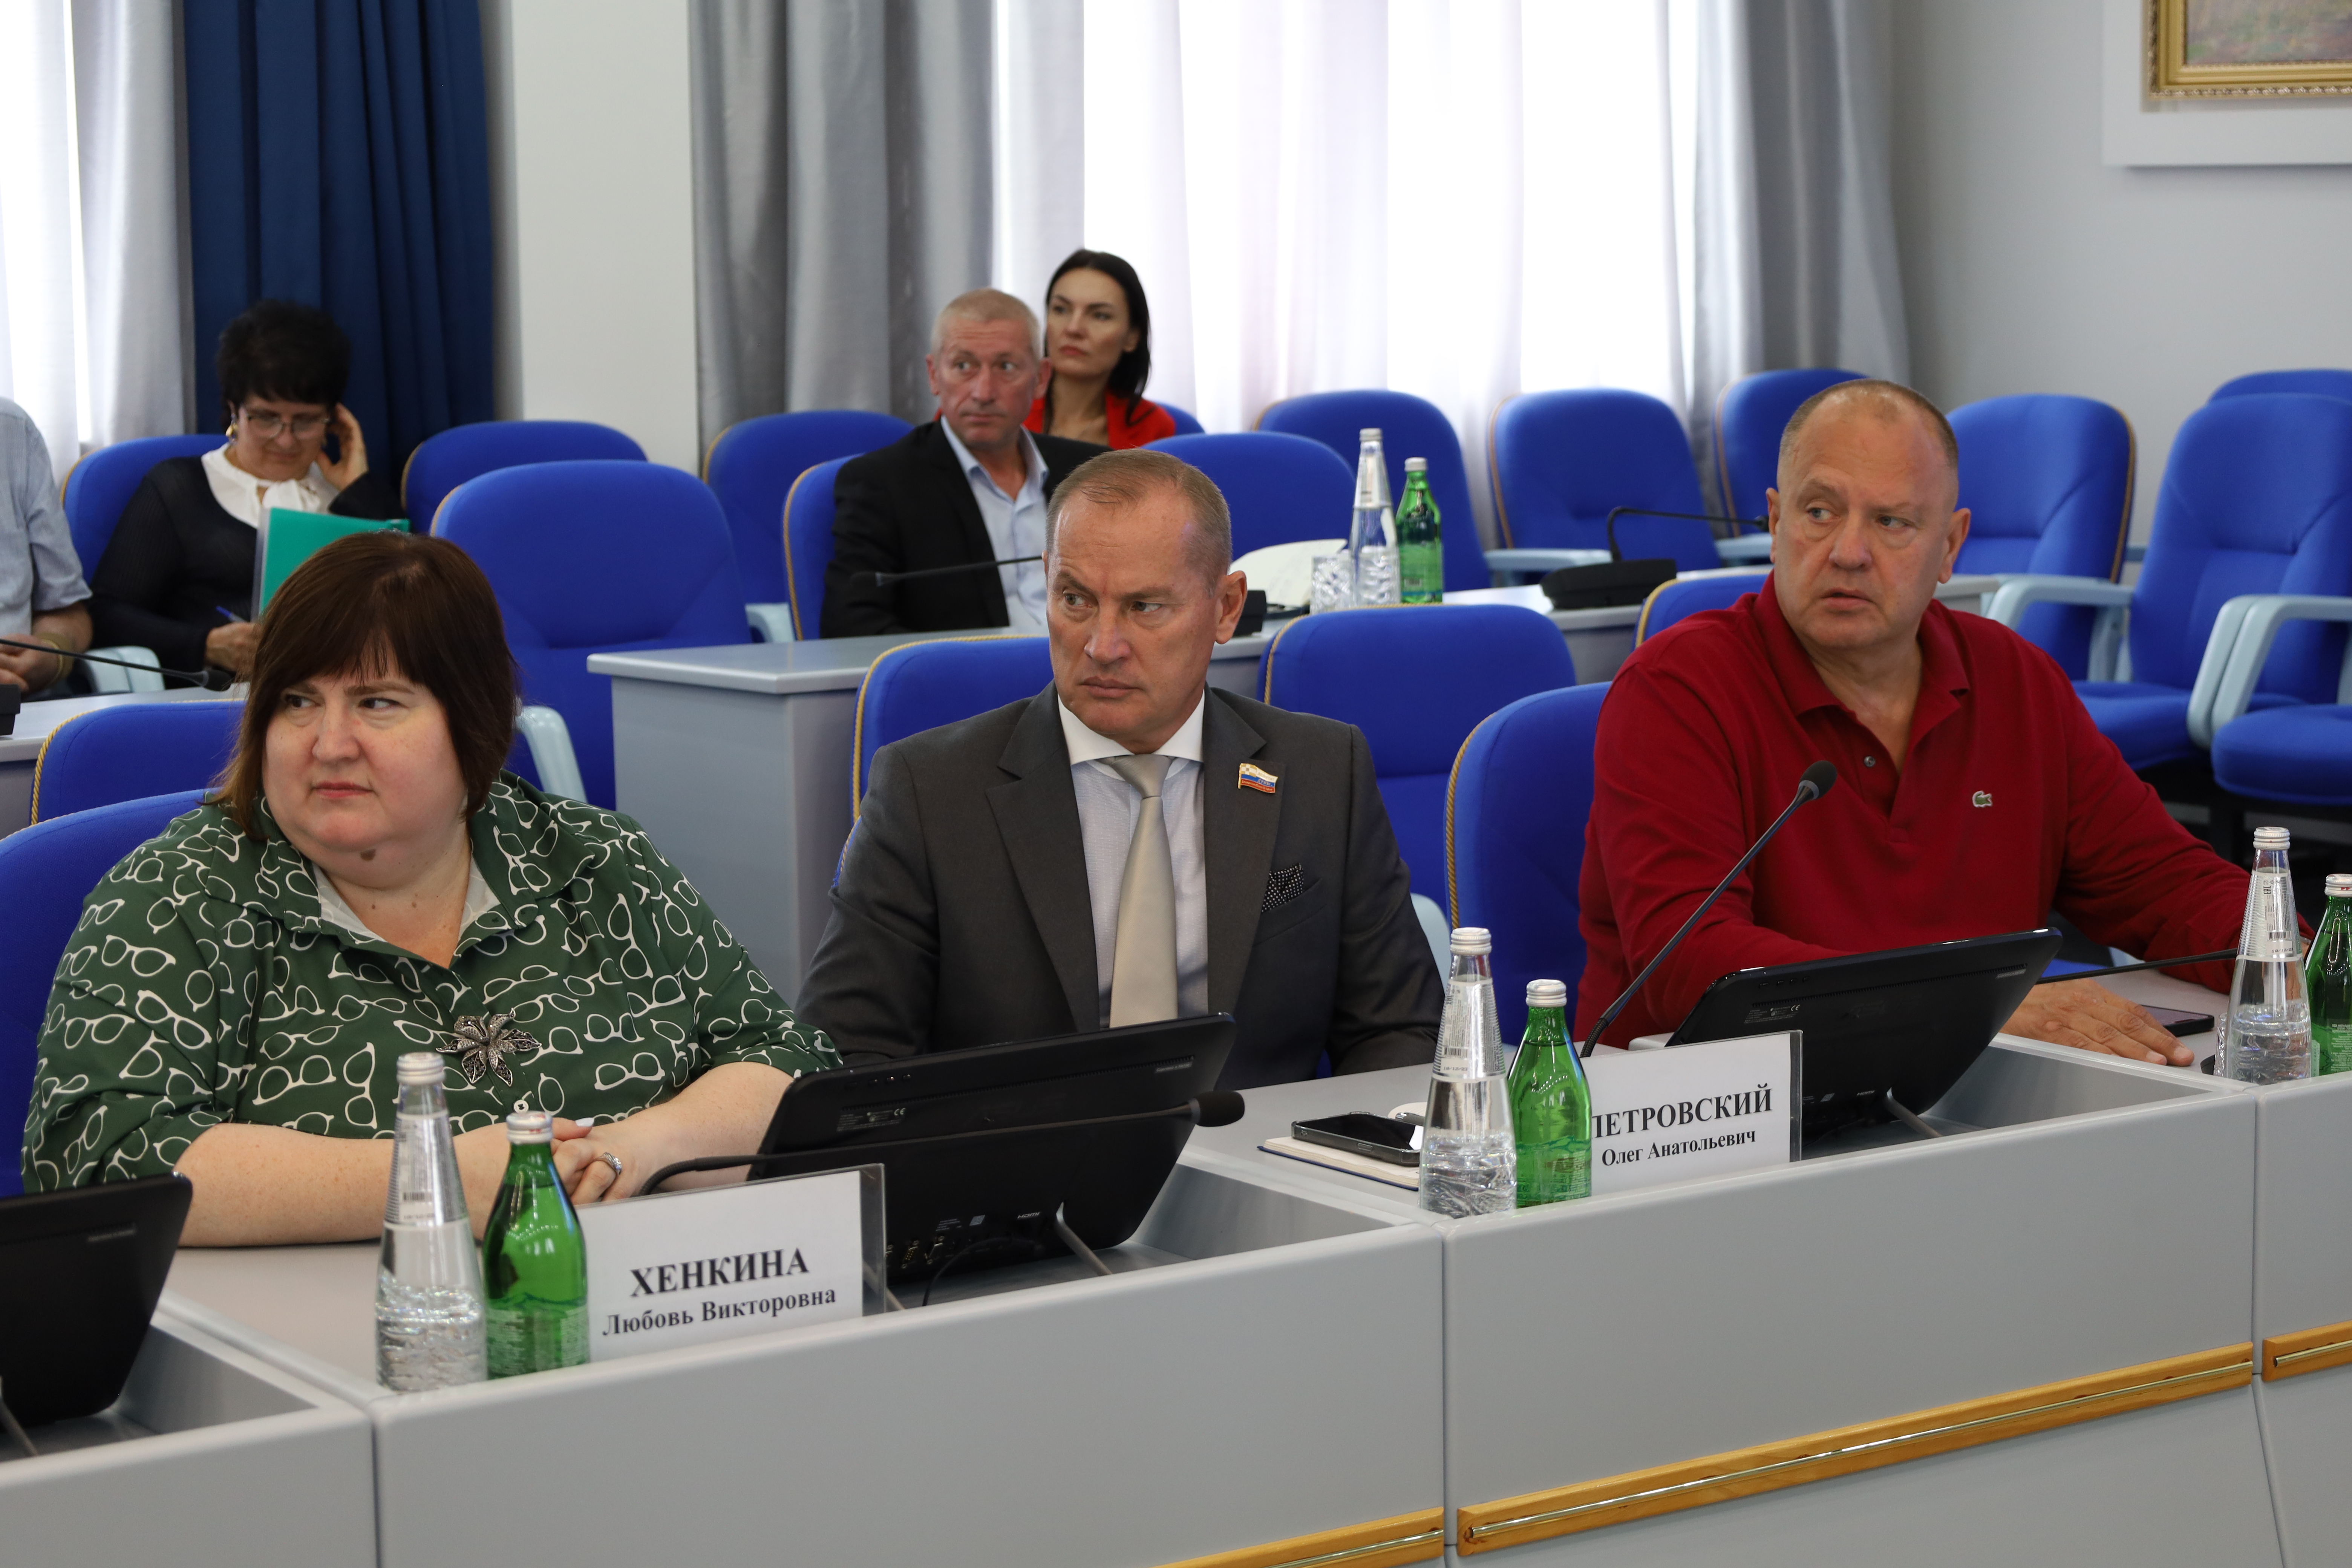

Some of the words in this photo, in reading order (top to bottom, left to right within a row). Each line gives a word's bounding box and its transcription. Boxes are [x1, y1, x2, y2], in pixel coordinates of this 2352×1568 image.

[1602, 1149, 1643, 1166] Олег
[1648, 1131, 1756, 1159] Анатольевич
[631, 1248, 809, 1298] ХЕНКИНА
[602, 1309, 694, 1337] Любовь
[702, 1289, 836, 1322] Викторовна
